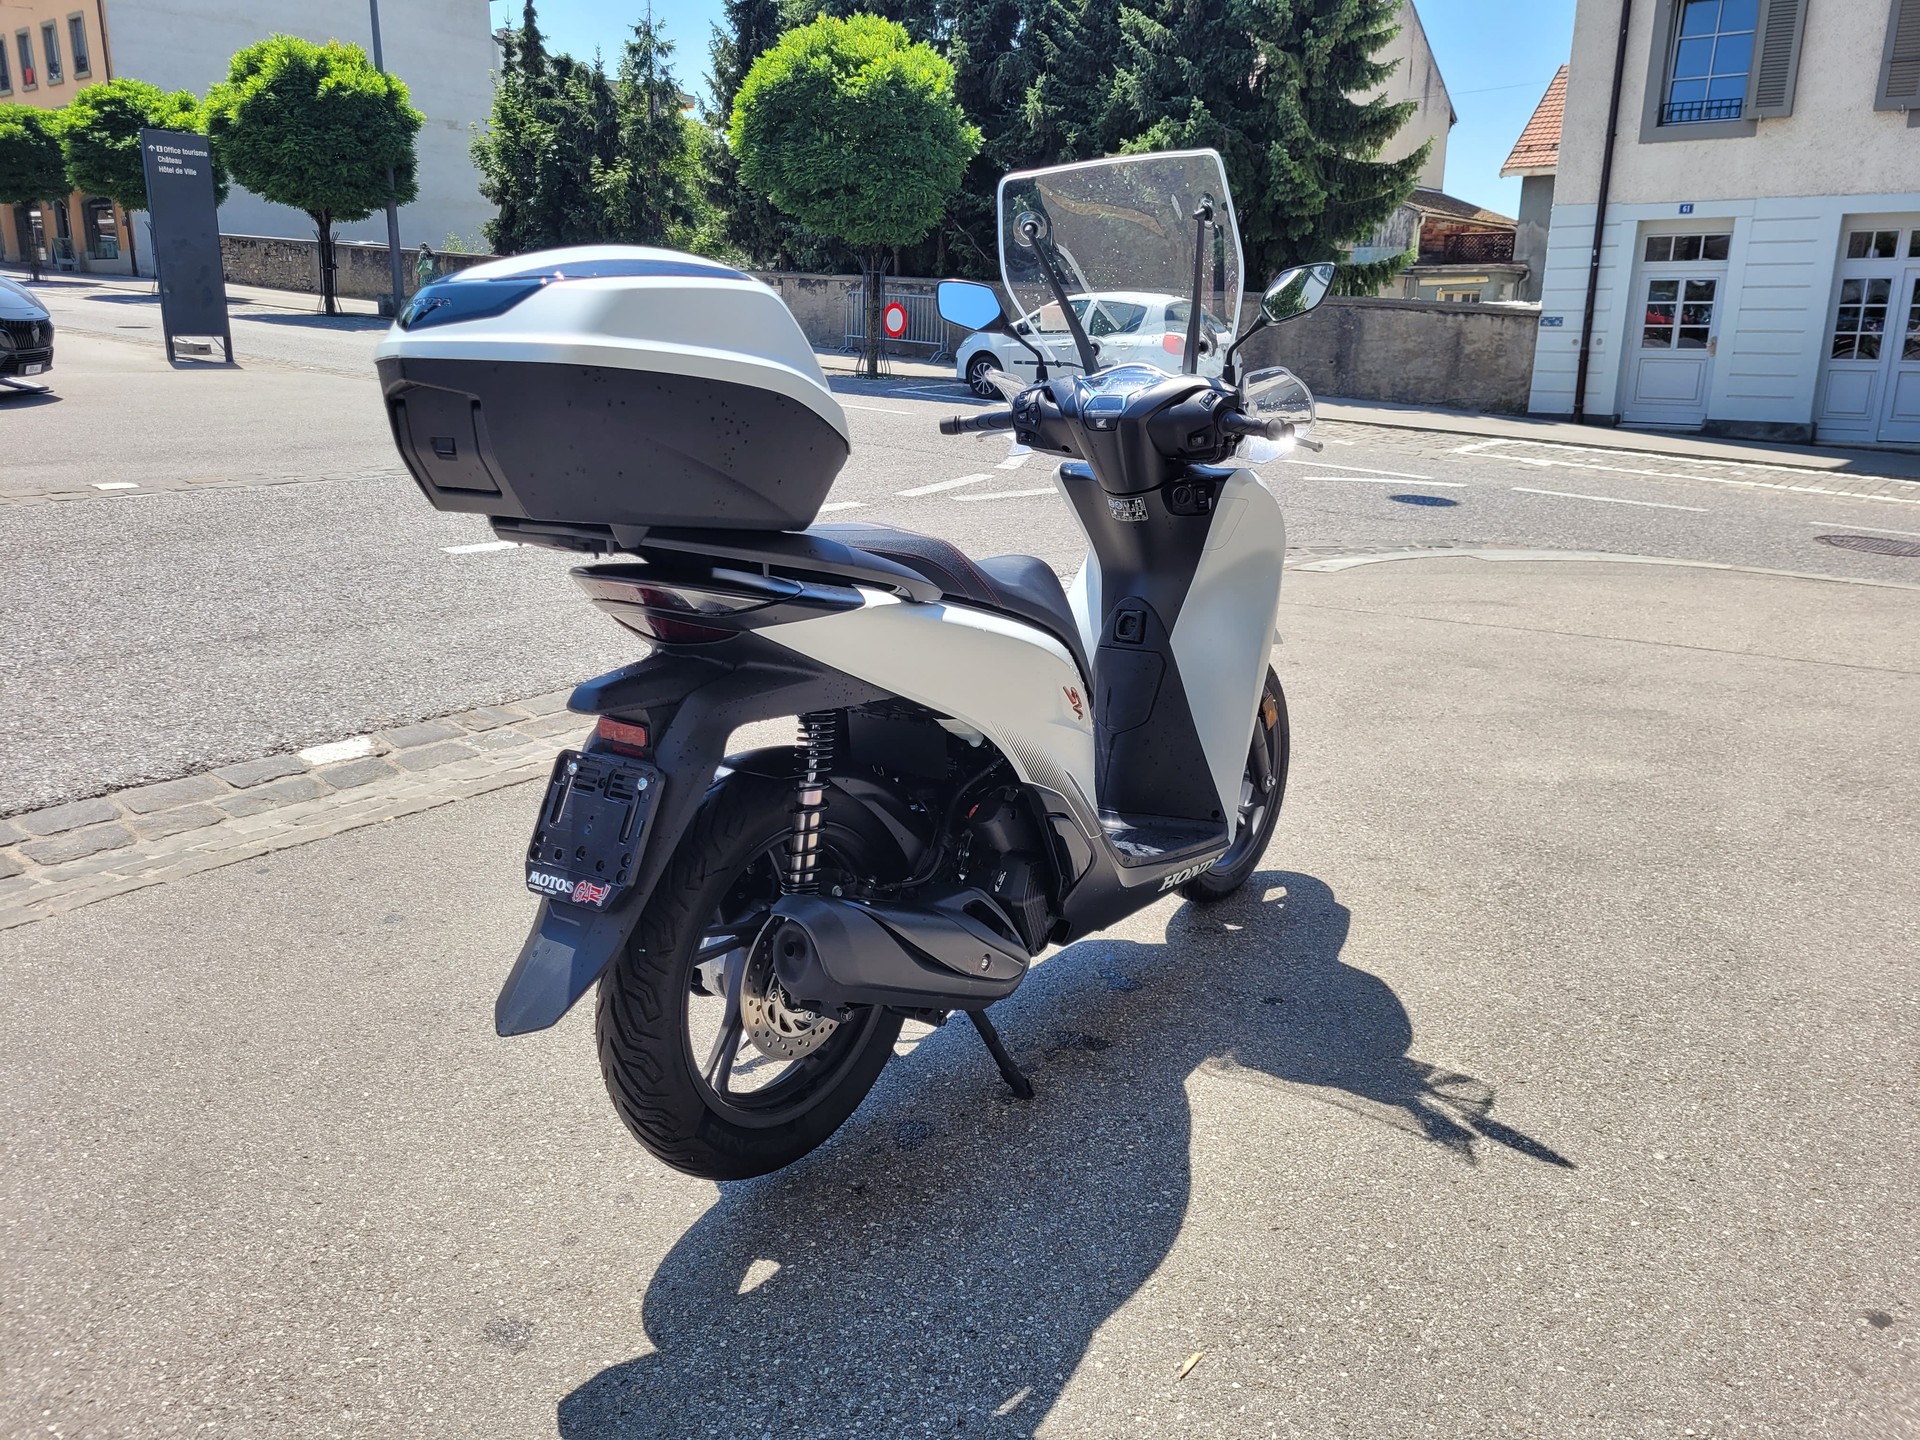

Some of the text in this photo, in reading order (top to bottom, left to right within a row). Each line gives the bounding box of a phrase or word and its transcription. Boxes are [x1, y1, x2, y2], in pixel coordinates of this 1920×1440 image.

[163, 145, 208, 158] Office tourisme
[157, 155, 182, 165] Château
[158, 165, 197, 176] Hôtel de Ville
[527, 870, 575, 894] MOTOS
